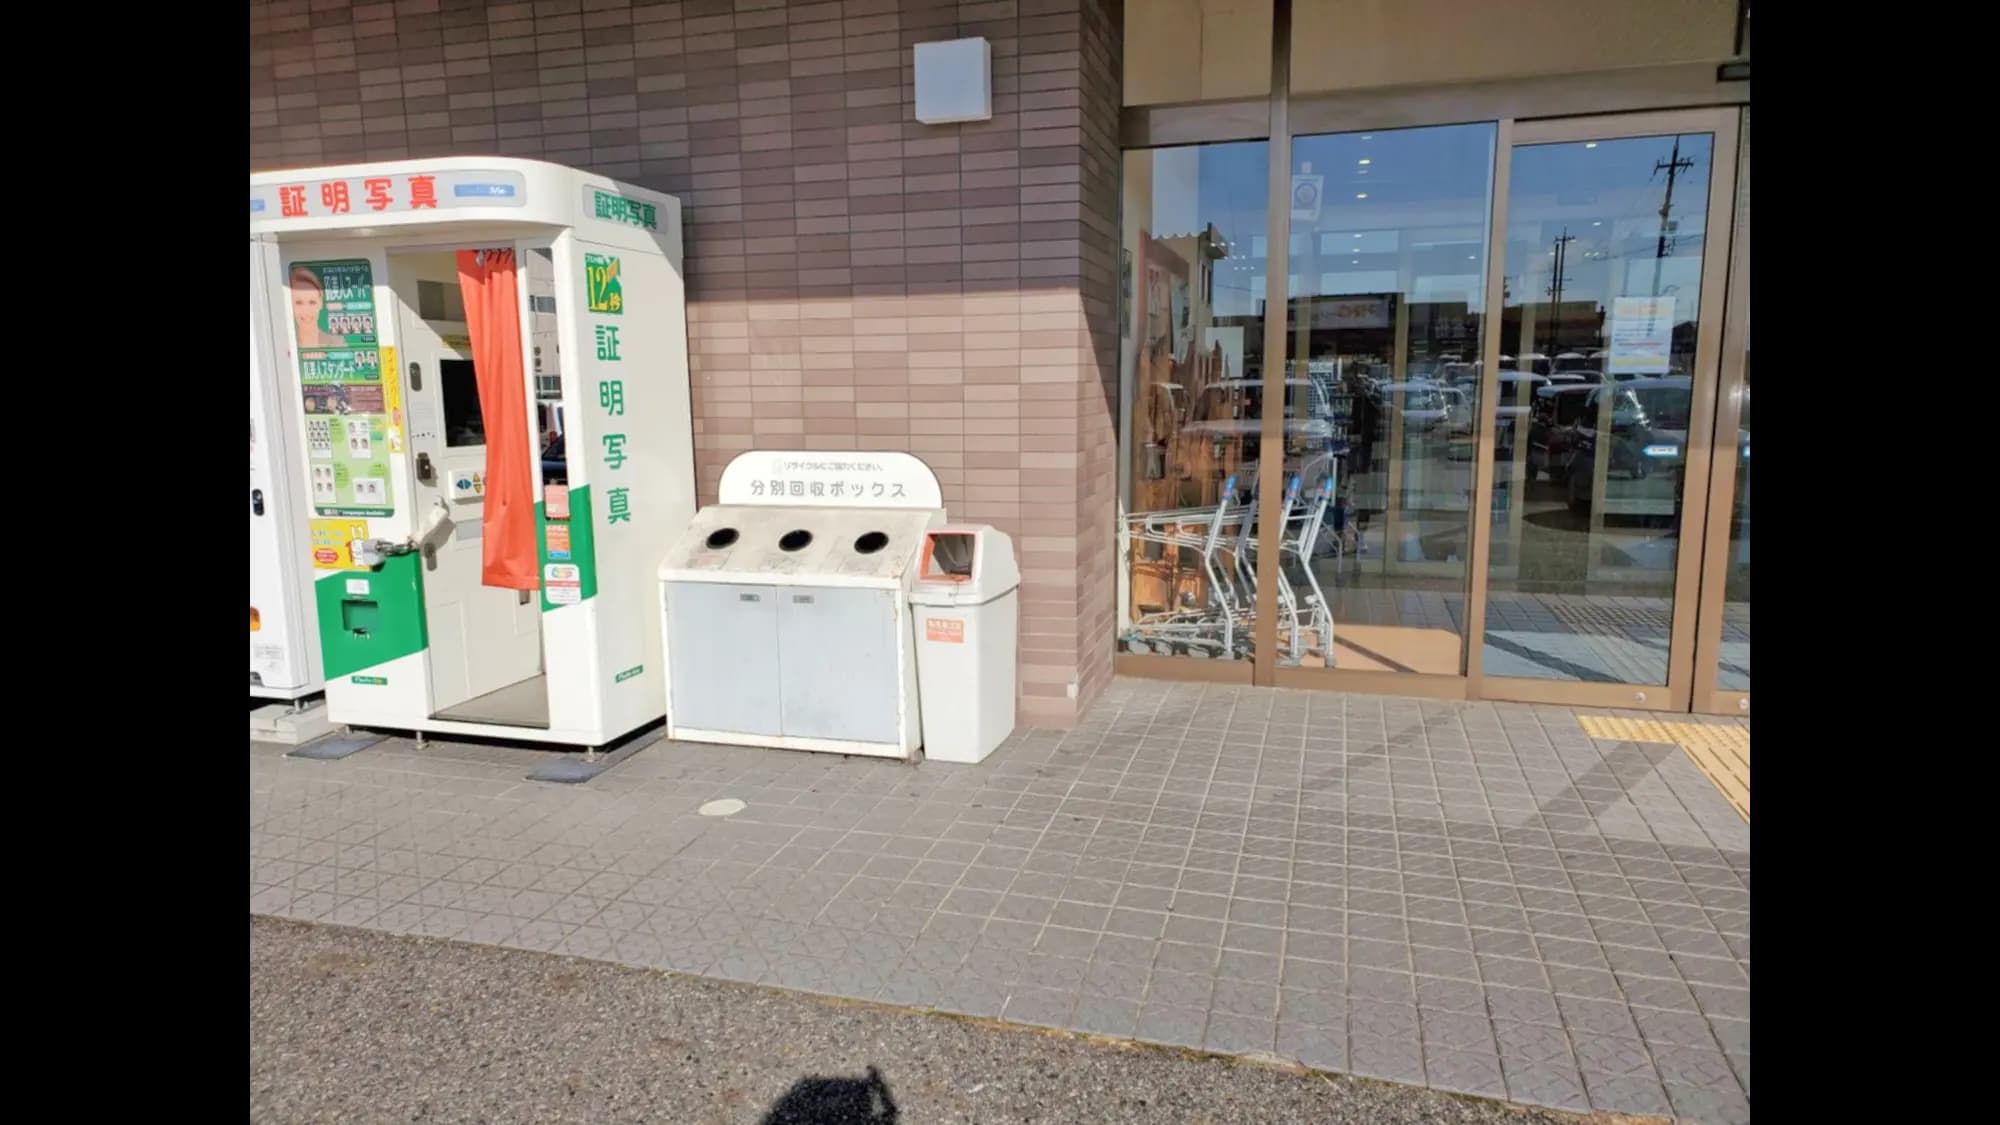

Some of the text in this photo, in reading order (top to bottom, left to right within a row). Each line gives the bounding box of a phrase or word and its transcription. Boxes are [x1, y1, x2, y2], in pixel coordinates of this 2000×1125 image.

[279, 175, 438, 218] 証明写真
[594, 191, 657, 231] 証明写真
[595, 324, 631, 525] 証明写真
[751, 479, 907, 497] 分別回収ボックス
